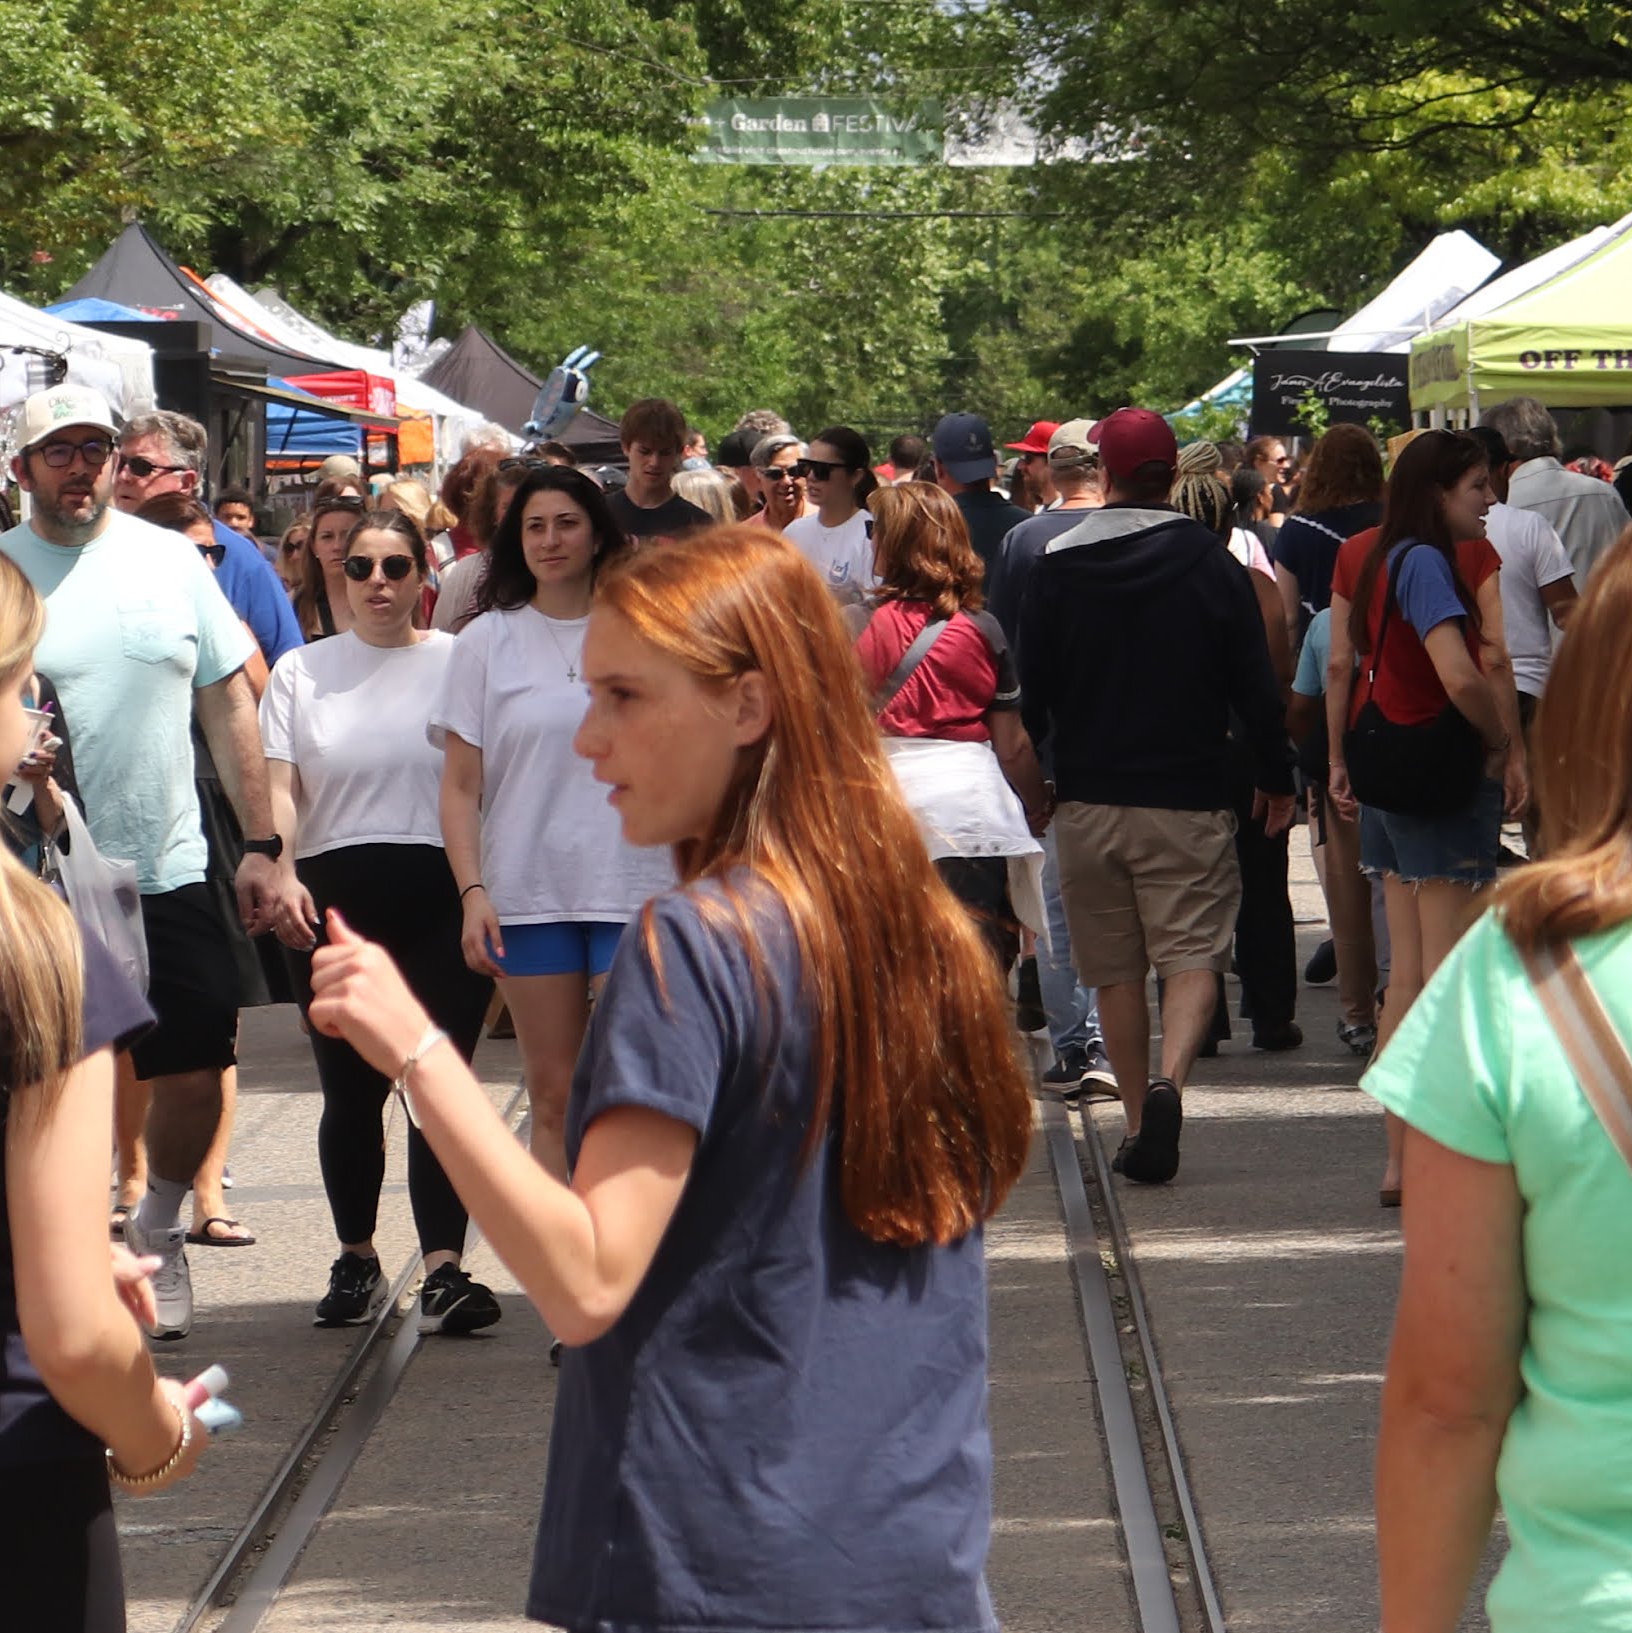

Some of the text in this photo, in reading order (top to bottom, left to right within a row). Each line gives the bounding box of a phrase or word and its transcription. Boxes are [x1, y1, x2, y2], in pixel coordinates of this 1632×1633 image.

[730, 113, 807, 133] Garden
[832, 113, 919, 133] FESTIVA
[1519, 348, 1584, 369] OFF
[1270, 373, 1309, 391] James
[1324, 372, 1405, 393] Evangelista
[1329, 397, 1393, 408] Photography
